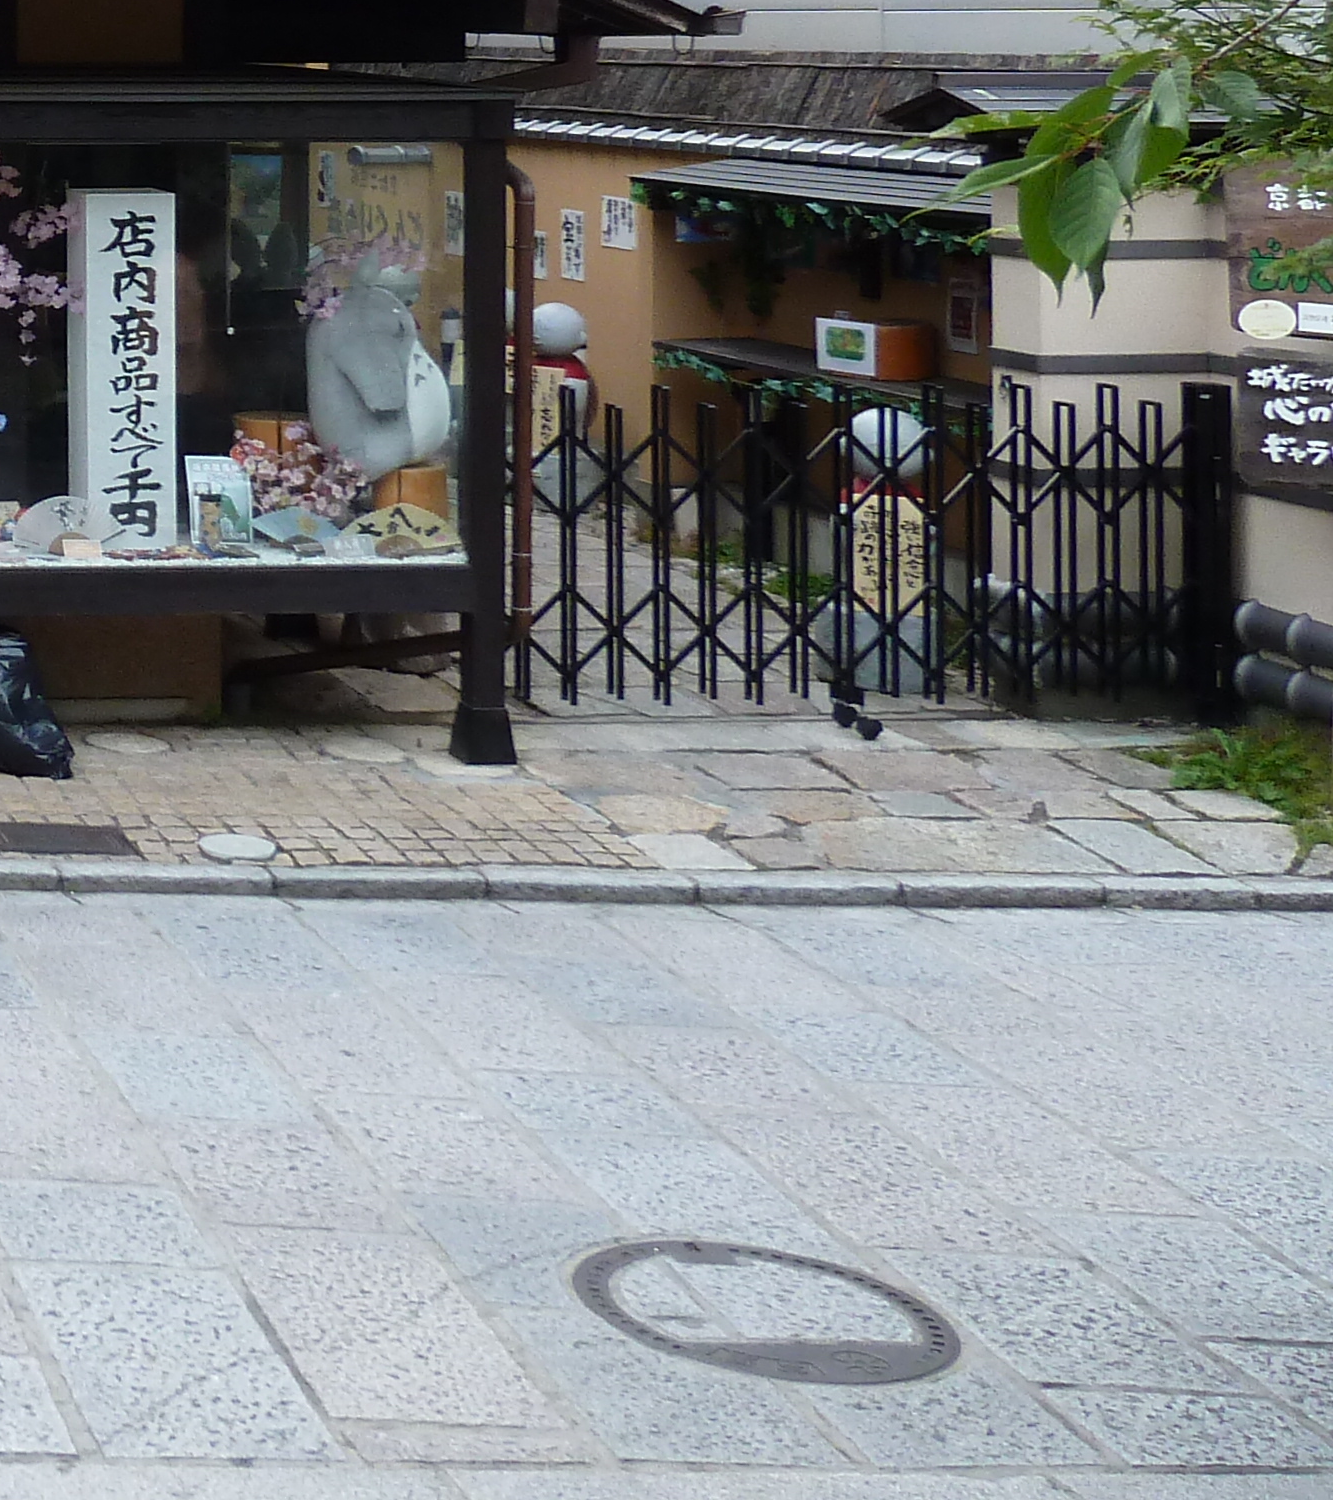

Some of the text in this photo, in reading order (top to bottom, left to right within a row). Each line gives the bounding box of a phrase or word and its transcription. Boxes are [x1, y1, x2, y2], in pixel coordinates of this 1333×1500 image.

[99, 211, 164, 537] 店内商品すべて千円
[1263, 396, 1333, 426] 心の
[1260, 433, 1333, 466] ギャラ
